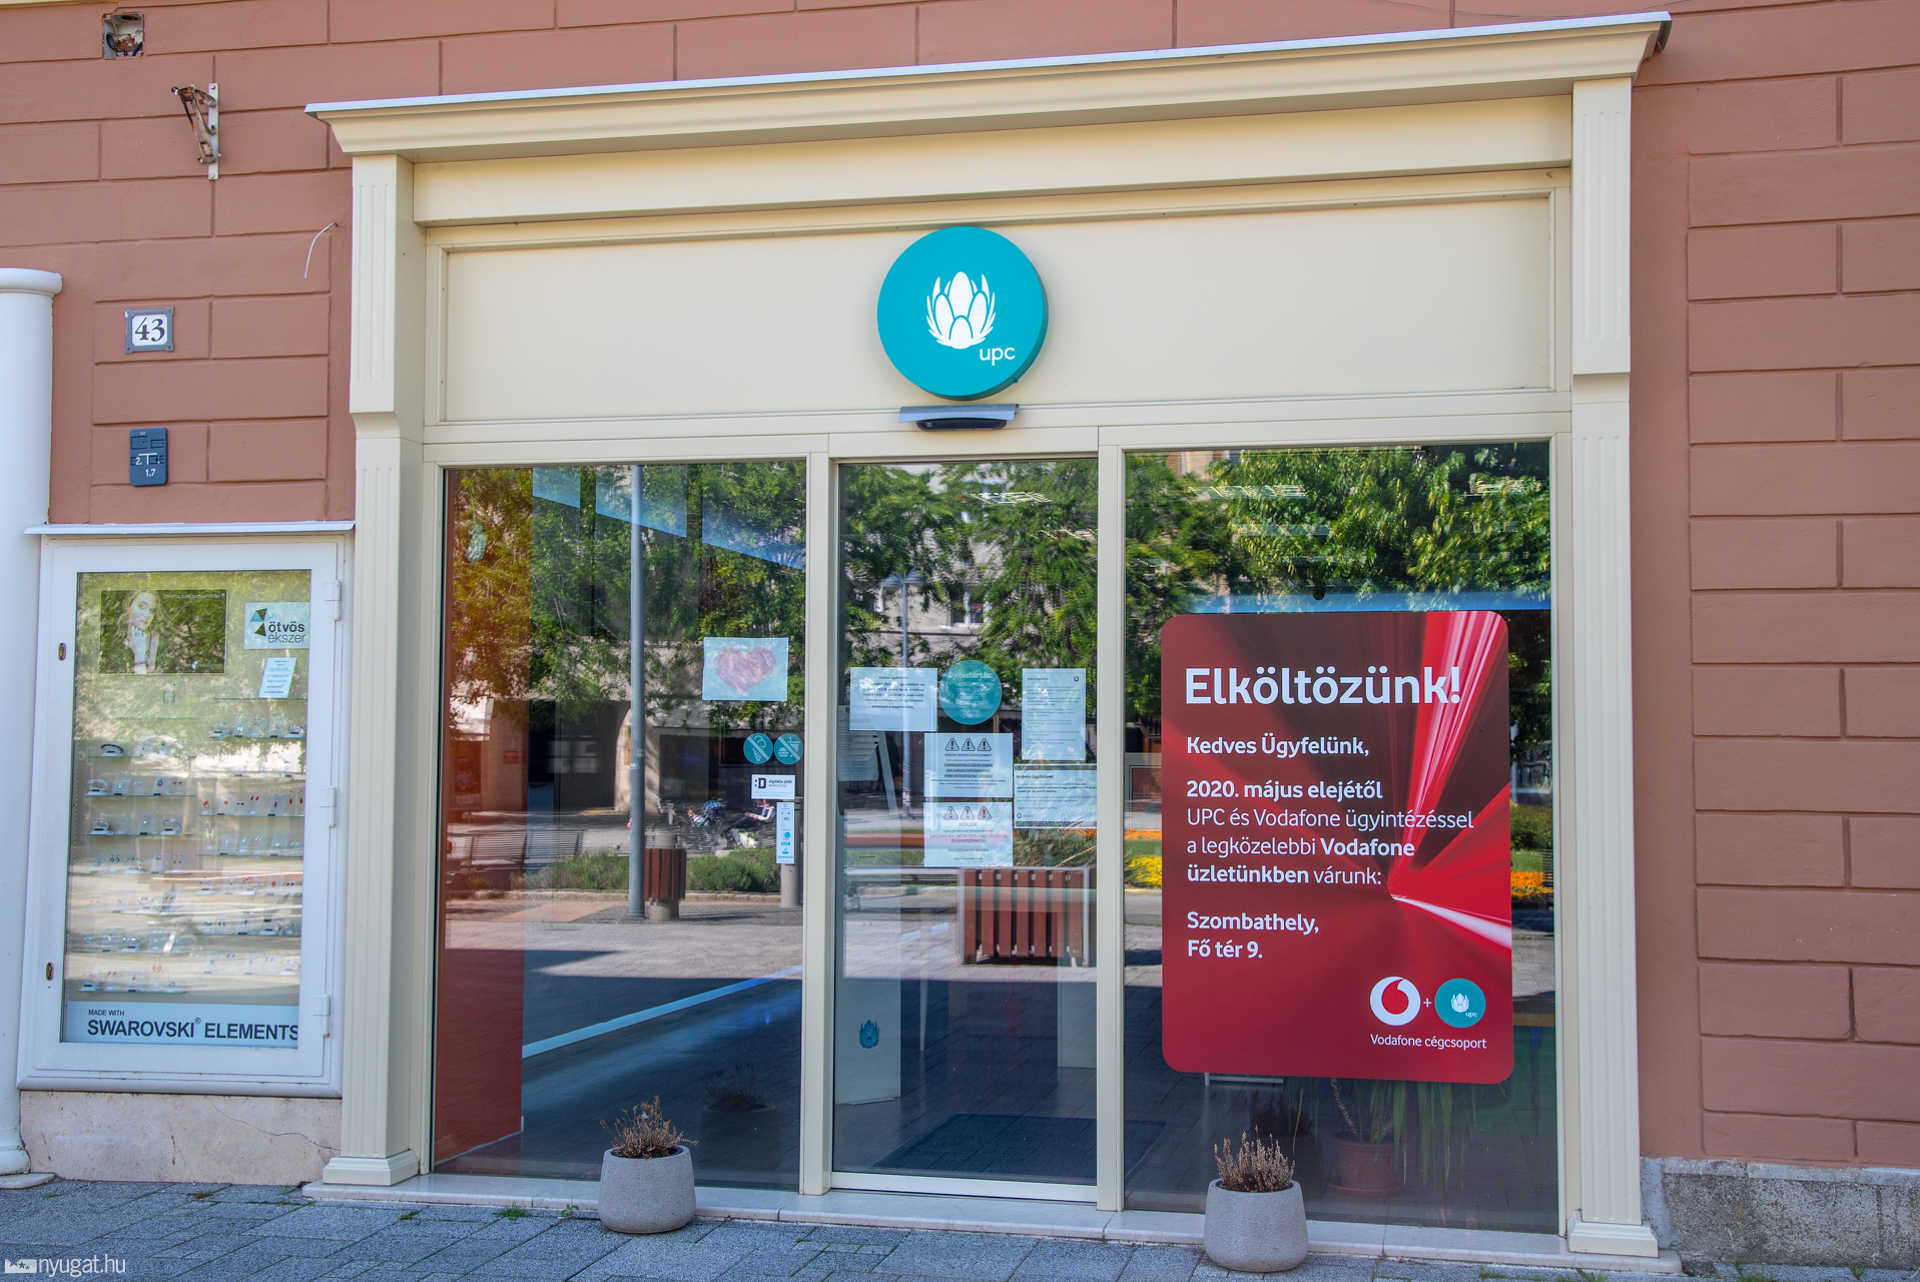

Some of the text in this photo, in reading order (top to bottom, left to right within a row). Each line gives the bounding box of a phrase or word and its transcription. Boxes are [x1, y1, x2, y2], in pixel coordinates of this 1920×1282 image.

[134, 316, 166, 342] 43
[979, 347, 1016, 366] upc
[268, 621, 305, 633] ötvös
[1185, 666, 1461, 705] Elköltözünk!
[1187, 733, 1369, 757] Kedves Ügyfelünk,
[1186, 780, 1383, 803] 2020. május elejétől
[1187, 808, 1474, 833] UPC és Vodafone ügyintézéssel
[1187, 836, 1415, 858] a legközelebbi Vodafone
[1187, 864, 1382, 885] üzletünkben várunk:
[1187, 911, 1319, 935] Szombathely,
[1188, 938, 1263, 959] Fő tér 9.
[204, 1022, 298, 1041] ELEMENTS
[1370, 1034, 1487, 1051] Vodafone cégcsoport
